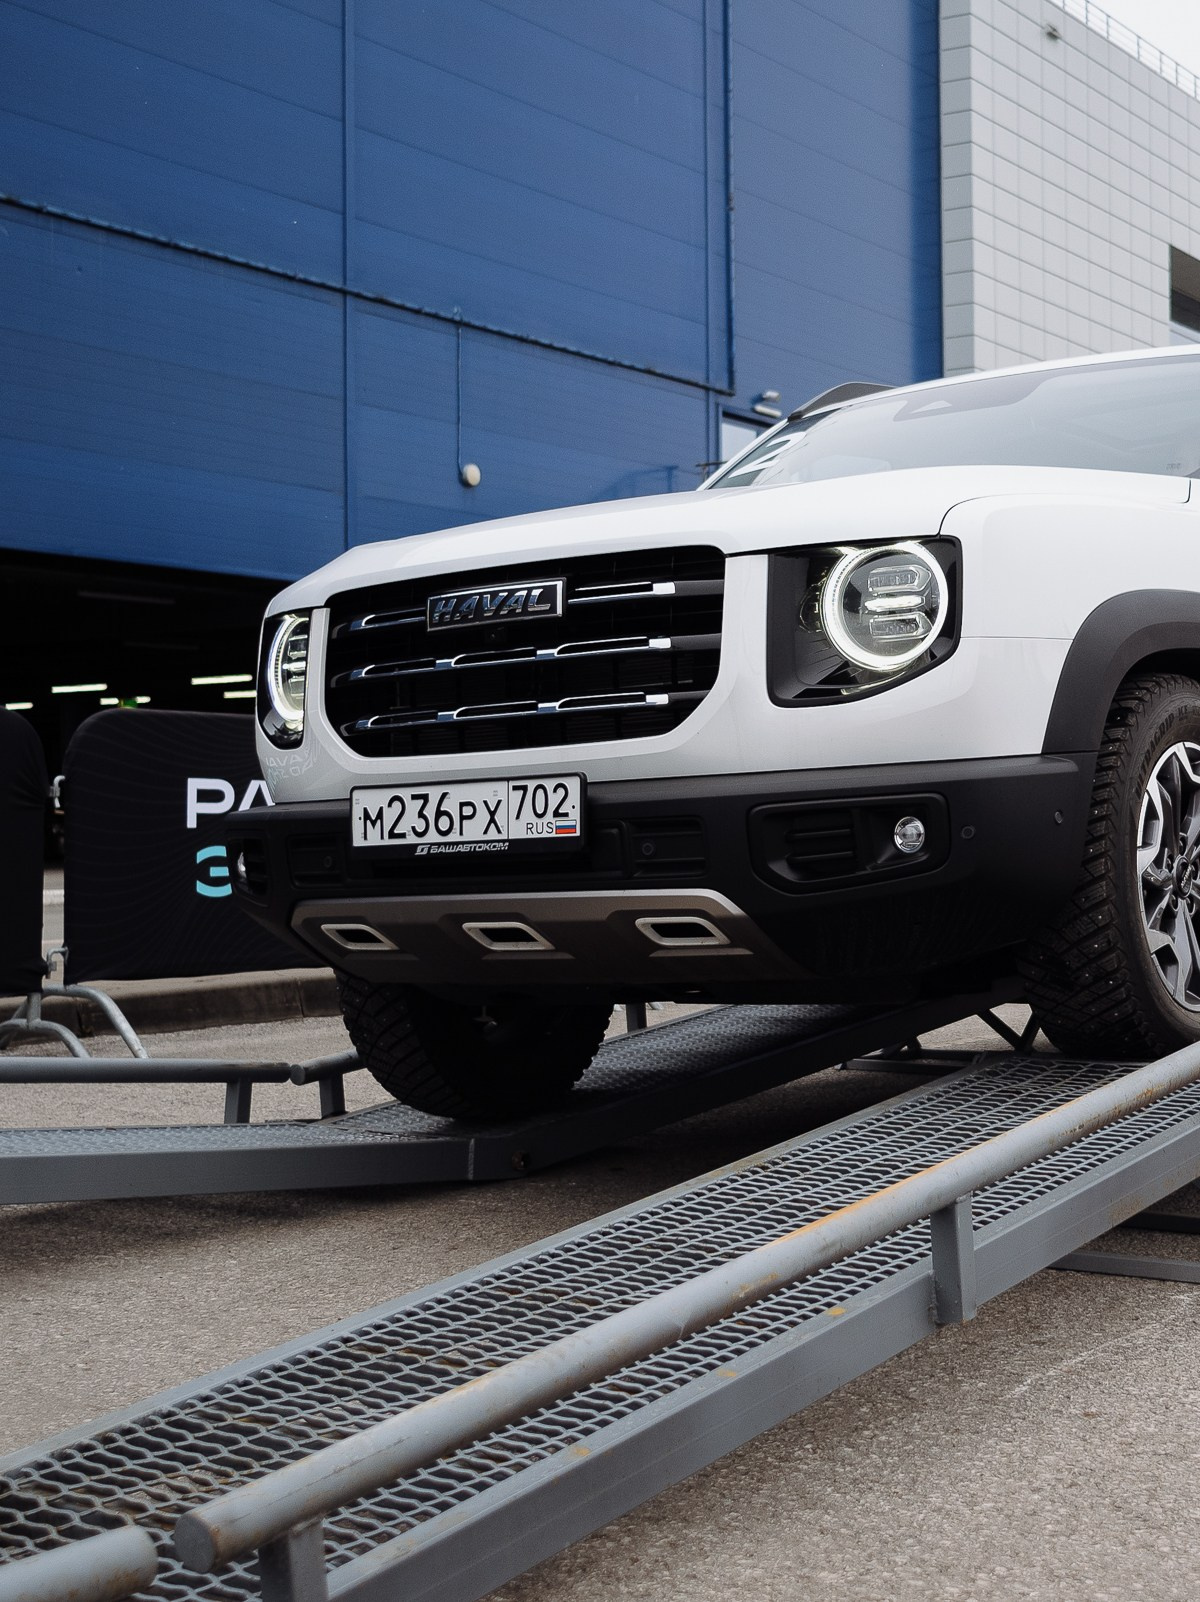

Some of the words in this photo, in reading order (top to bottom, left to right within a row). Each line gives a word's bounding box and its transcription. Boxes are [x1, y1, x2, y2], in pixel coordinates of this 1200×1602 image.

[432, 589, 550, 623] HAVAL
[512, 782, 570, 820] 702
[526, 821, 554, 836] RUS
[429, 842, 509, 854] БАШАВТОКОМ
